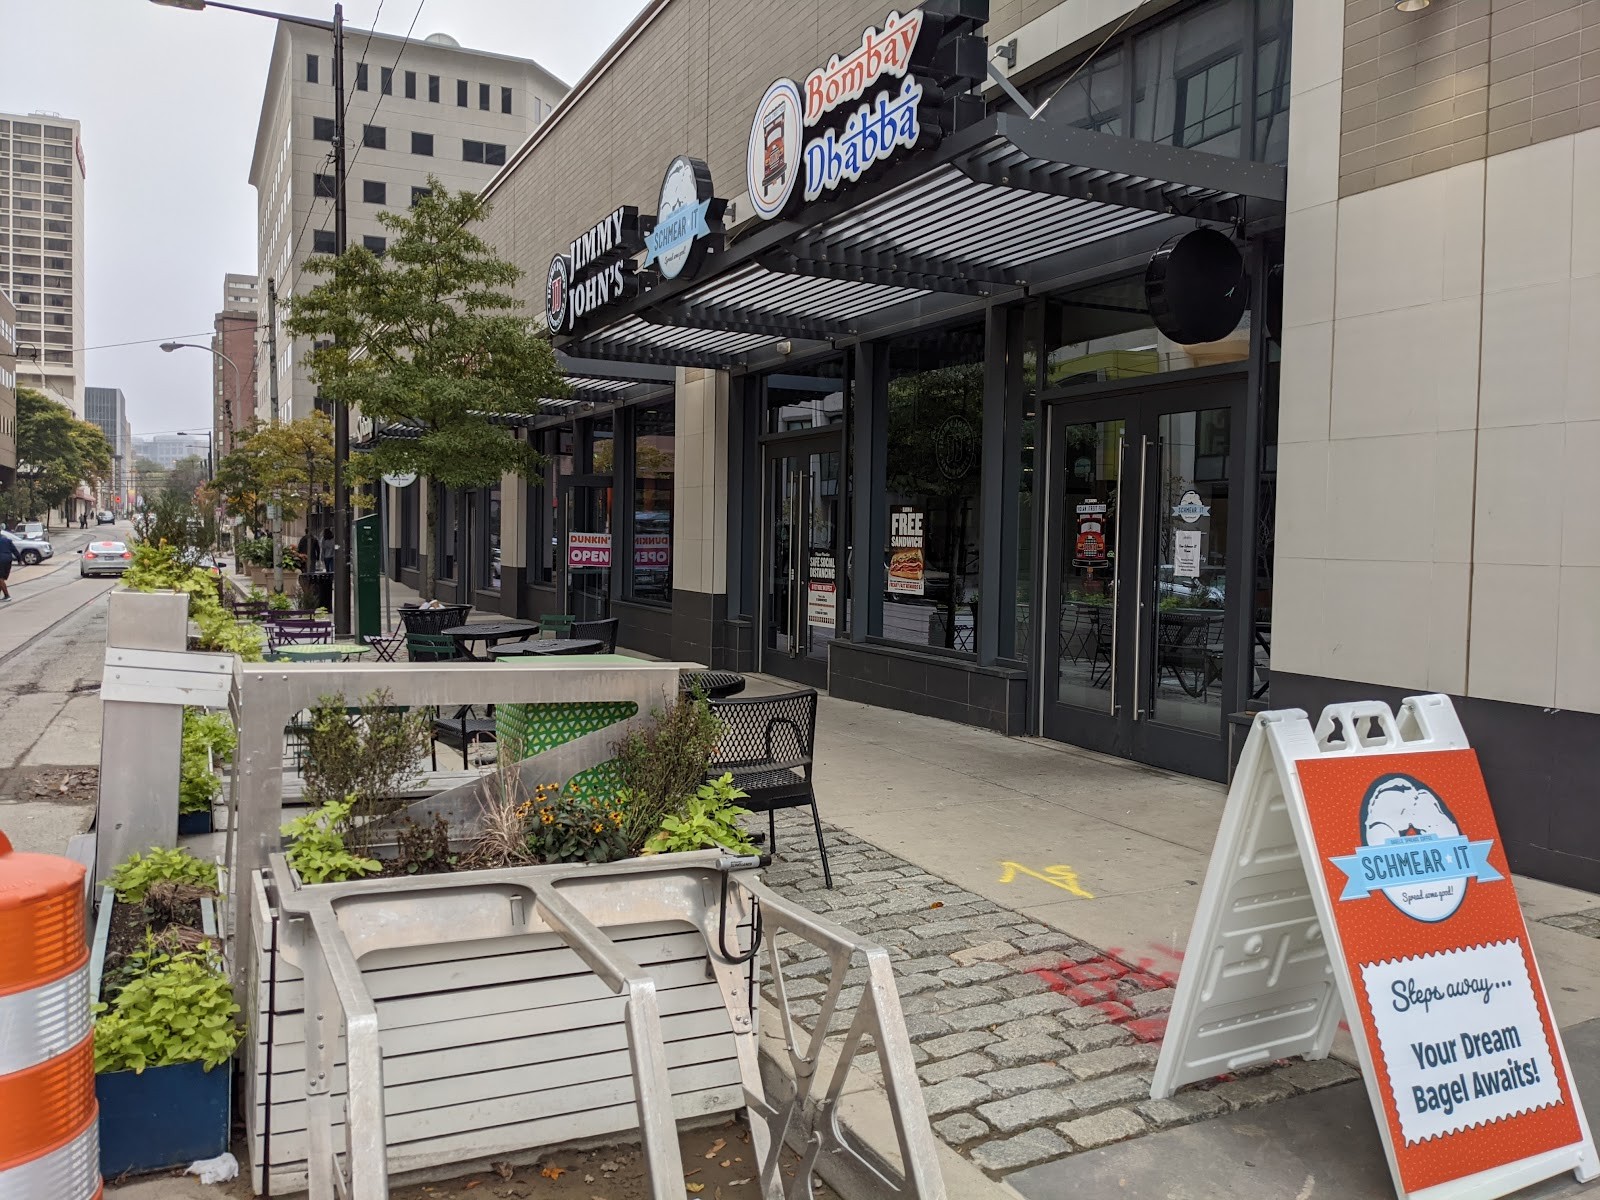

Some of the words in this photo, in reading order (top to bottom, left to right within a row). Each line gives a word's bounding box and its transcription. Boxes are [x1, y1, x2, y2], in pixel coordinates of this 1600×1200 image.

[807, 18, 919, 118] Bombay
[807, 83, 919, 193] Dhabba
[569, 206, 625, 283] JIMMY
[654, 216, 687, 251] SCHMEAR
[690, 208, 699, 230] IT
[568, 259, 624, 330] JOHN'S
[891, 512, 924, 536] FREE
[1178, 506, 1198, 514] SCHMEAR
[570, 535, 611, 545] DUNKIN'
[571, 550, 609, 562] OPEN
[891, 535, 923, 548] SANDWICH
[809, 557, 820, 567] SAFE
[820, 557, 835, 568] SOCIAL
[809, 568, 835, 579] DISTANCING
[1361, 848, 1446, 881] SCHMEAR
[1453, 846, 1470, 870] IT
[1402, 889, 1424, 905] Spread
[1438, 885, 1454, 902] good!
[1391, 978, 1445, 1013] Steps
[1446, 978, 1512, 1004] away...
[1410, 1037, 1458, 1070] Your
[1460, 1025, 1522, 1060] Dream
[1411, 1073, 1470, 1116] Bagel
[1472, 1057, 1541, 1099] Awaits!
